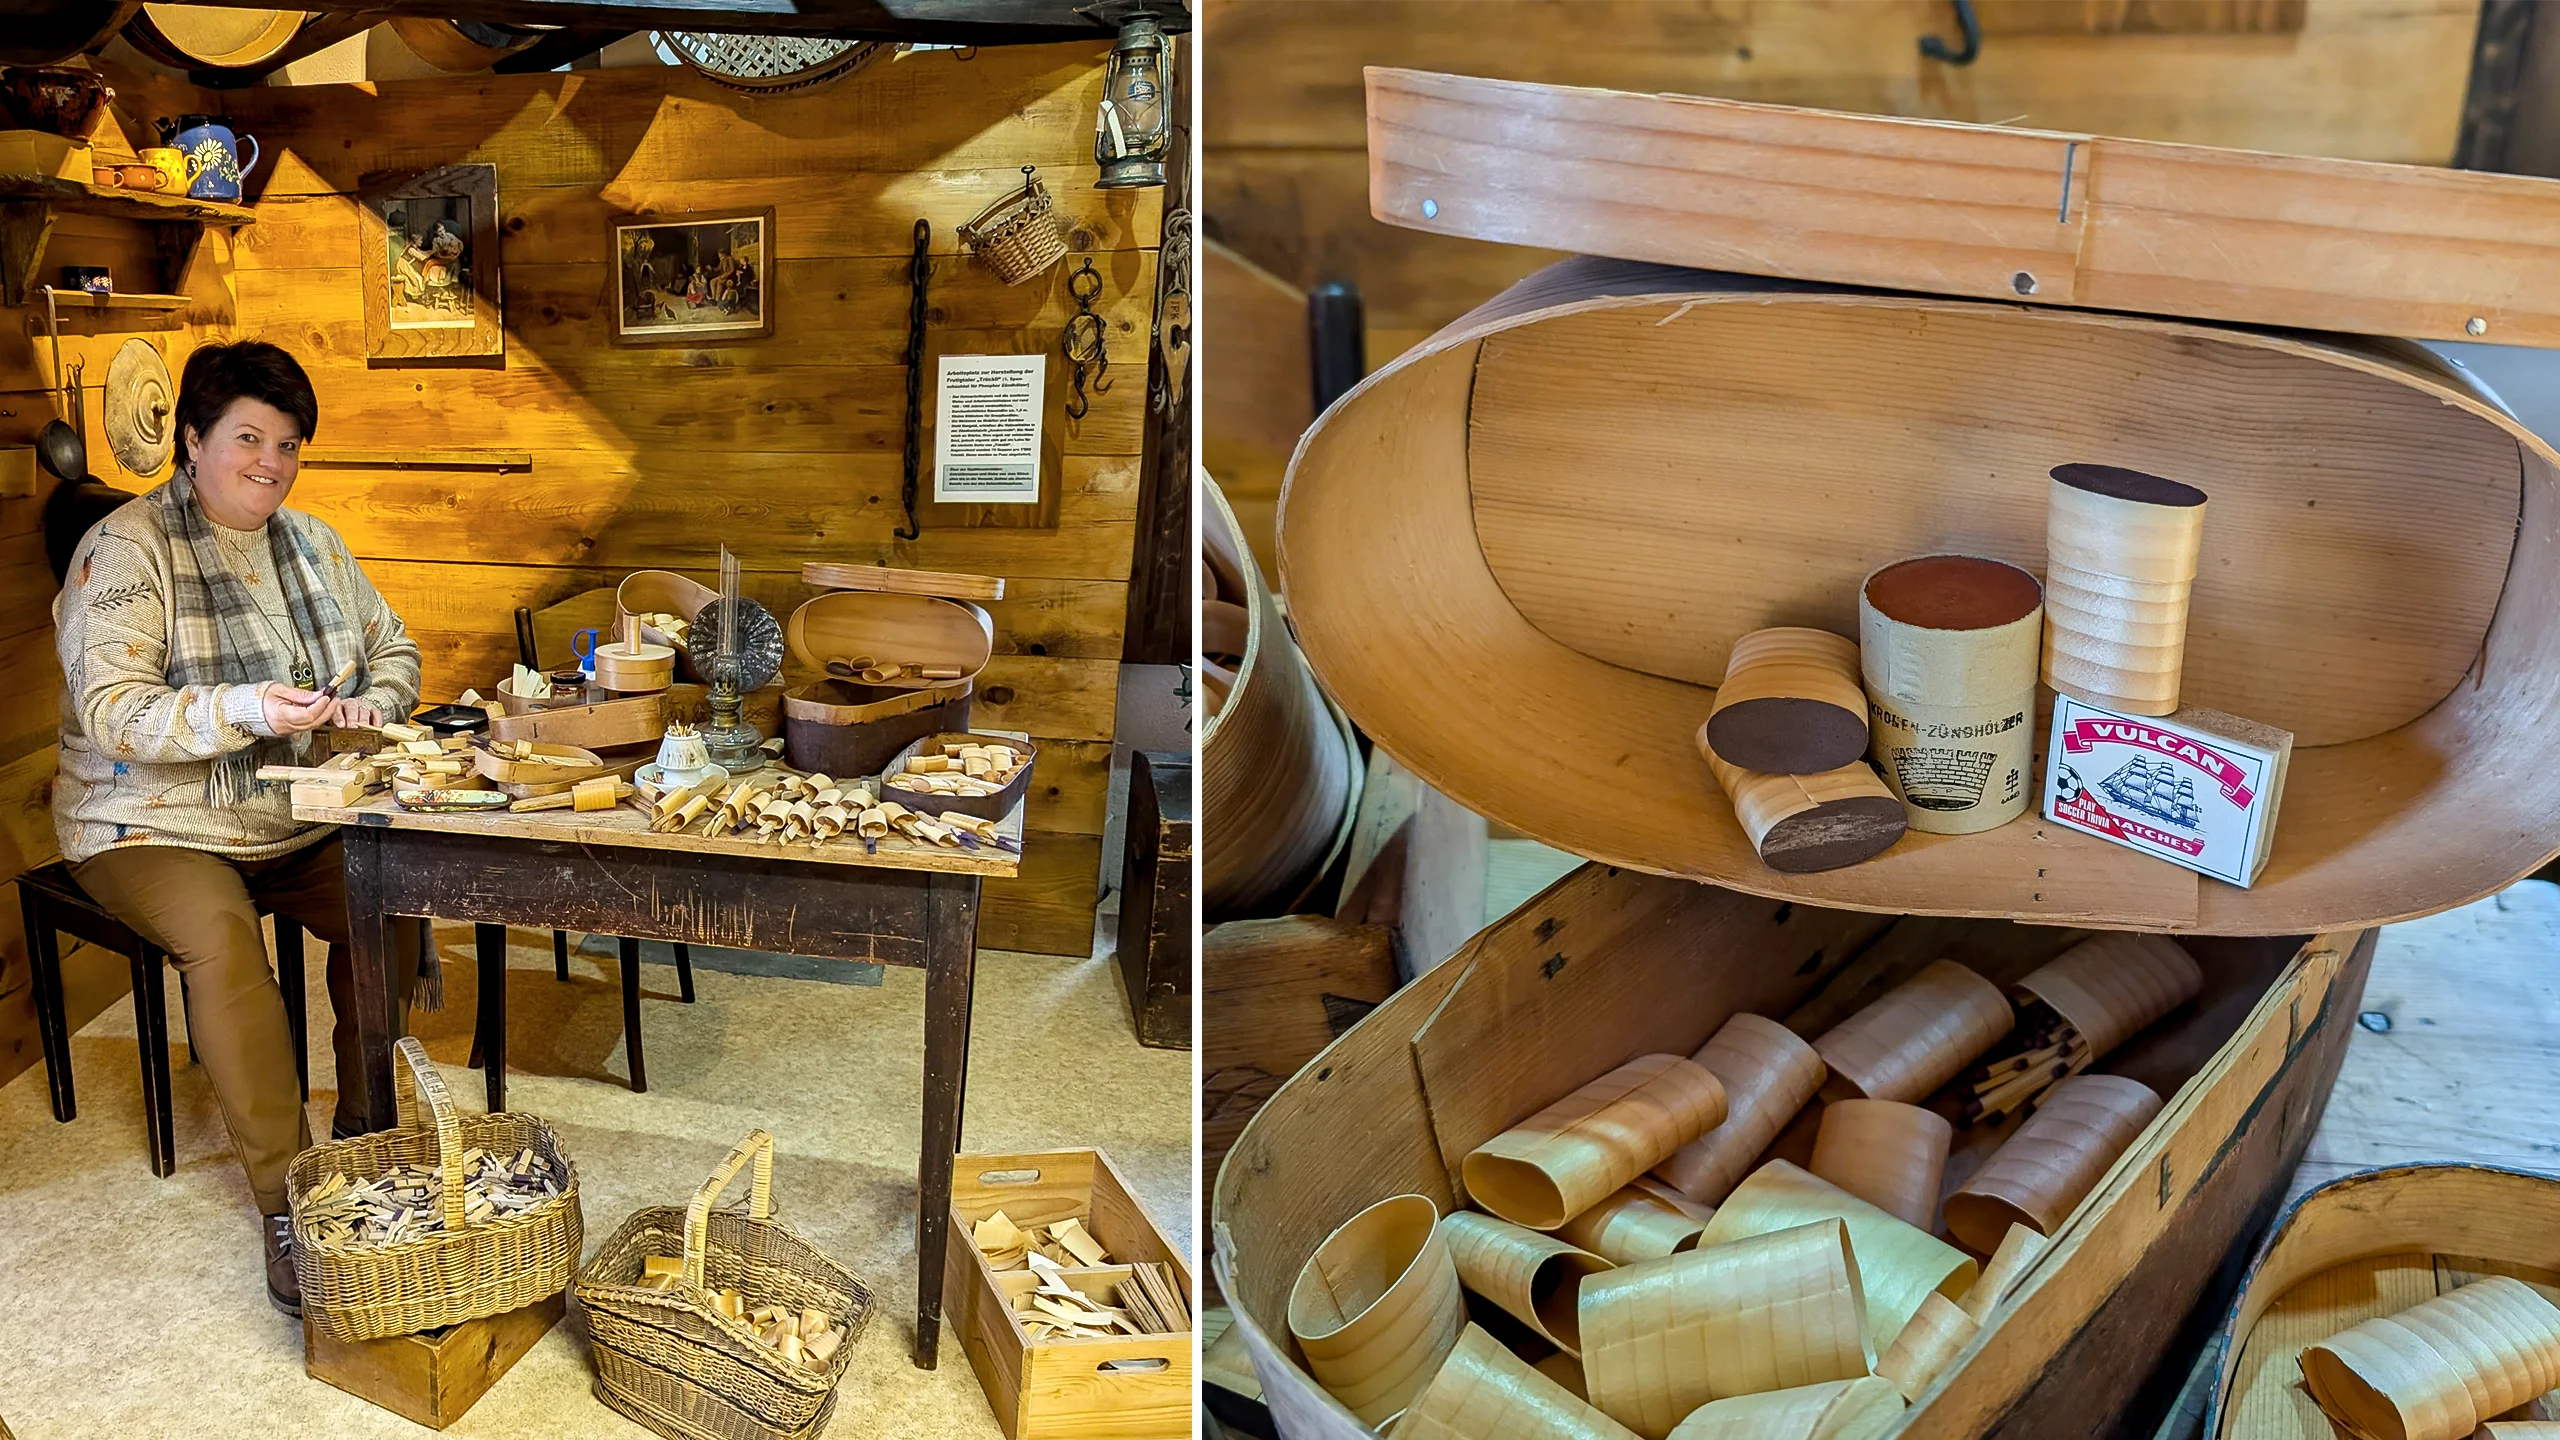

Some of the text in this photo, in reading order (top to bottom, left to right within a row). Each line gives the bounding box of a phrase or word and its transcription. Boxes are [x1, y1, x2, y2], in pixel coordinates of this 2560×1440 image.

[2092, 723, 2225, 776] VULCAN
[2058, 802, 2085, 820] SOCCER
[2087, 812, 2110, 829] TRIVIA
[2078, 798, 2096, 812] PLAY
